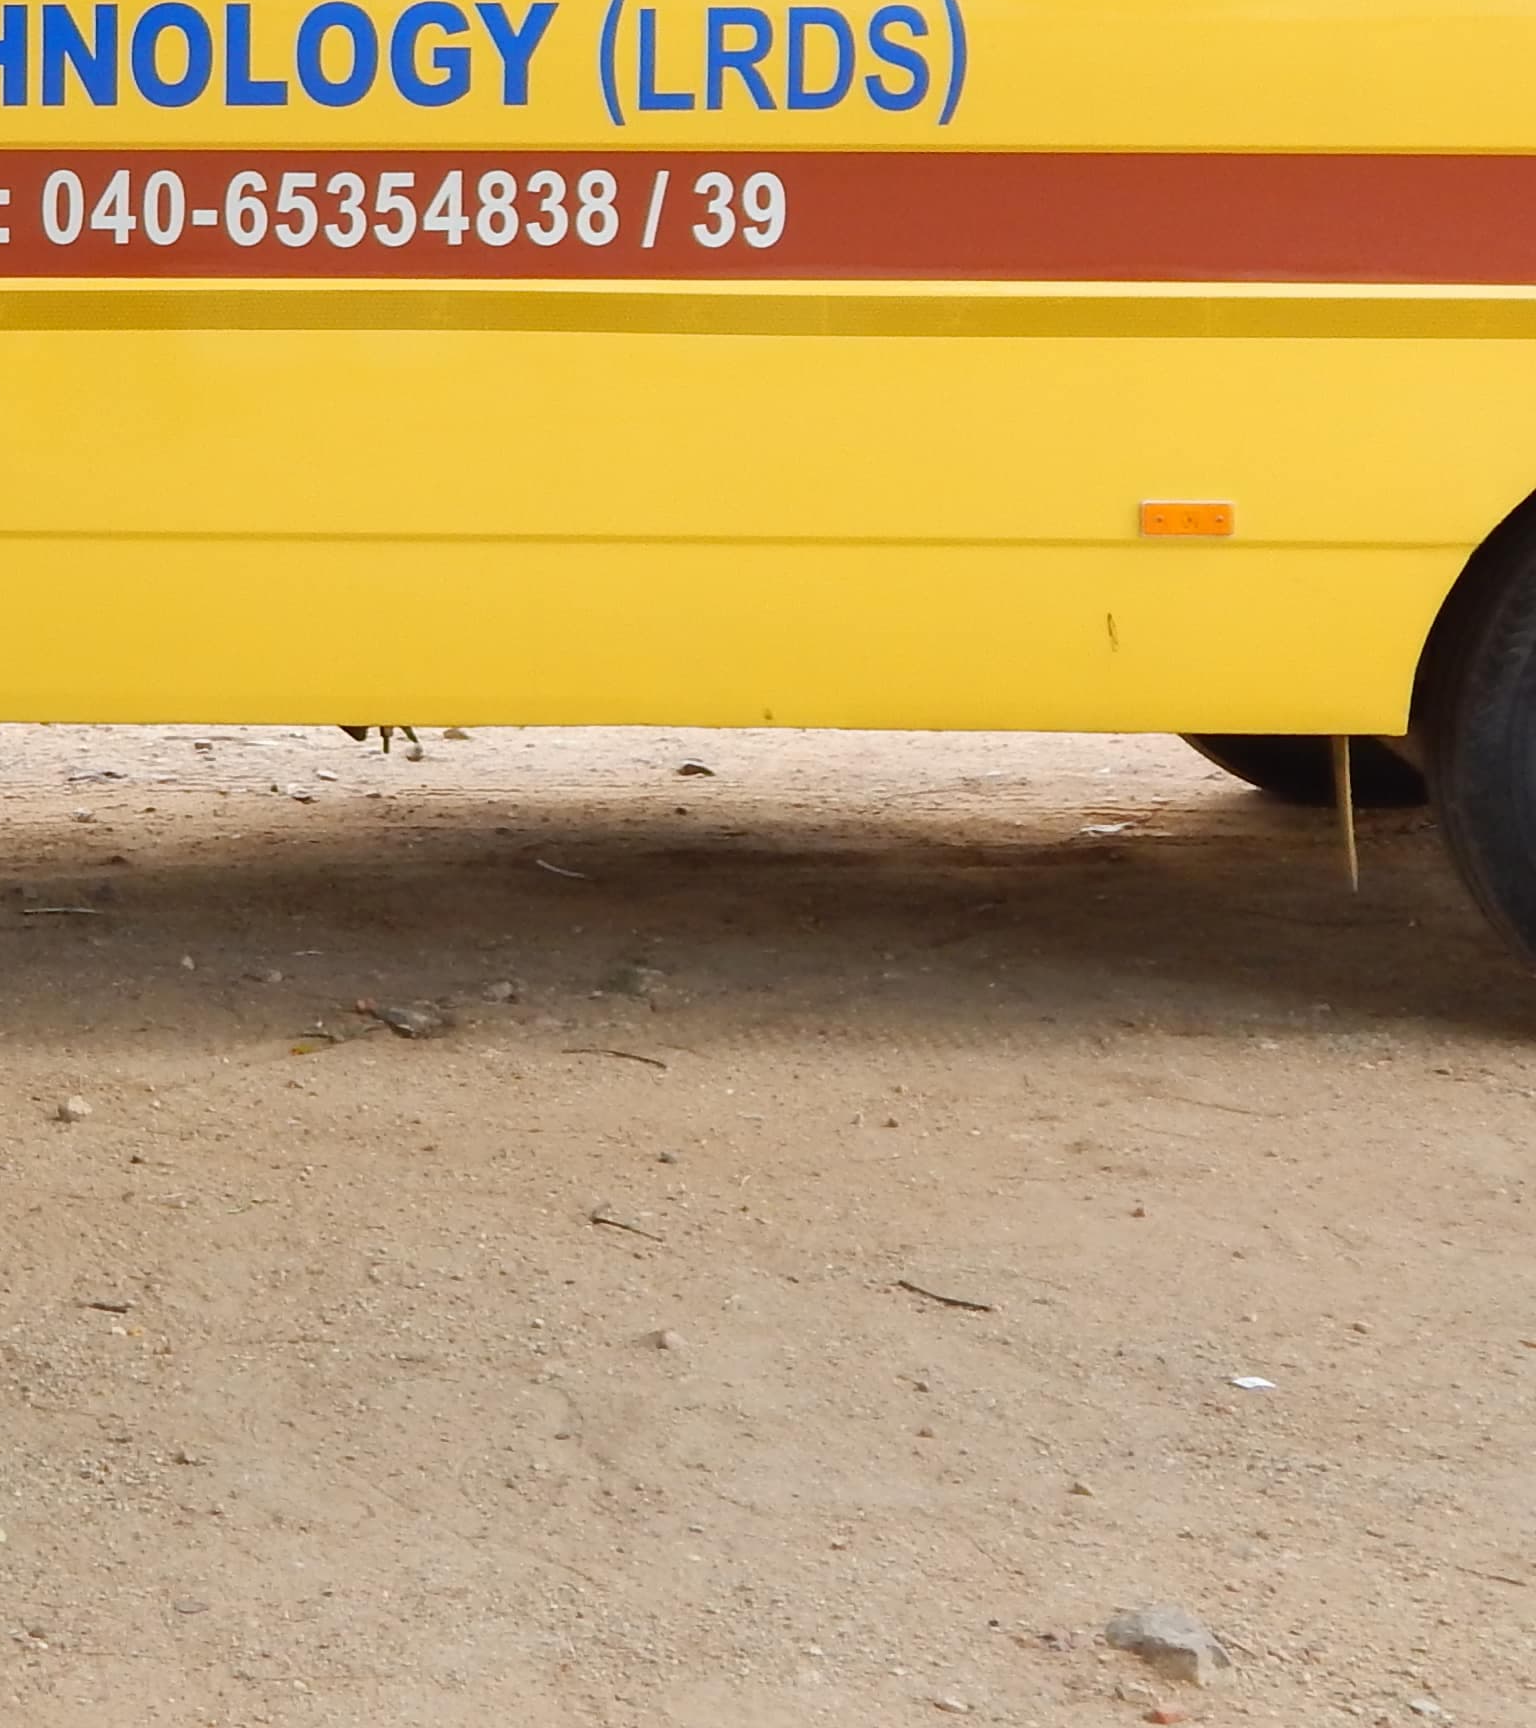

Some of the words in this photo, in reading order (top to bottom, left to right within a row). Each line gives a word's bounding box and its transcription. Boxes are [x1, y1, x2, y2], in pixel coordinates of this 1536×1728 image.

[41, 169, 619, 249] 040-65354838
[641, 170, 670, 249] /
[692, 171, 786, 249] 39
